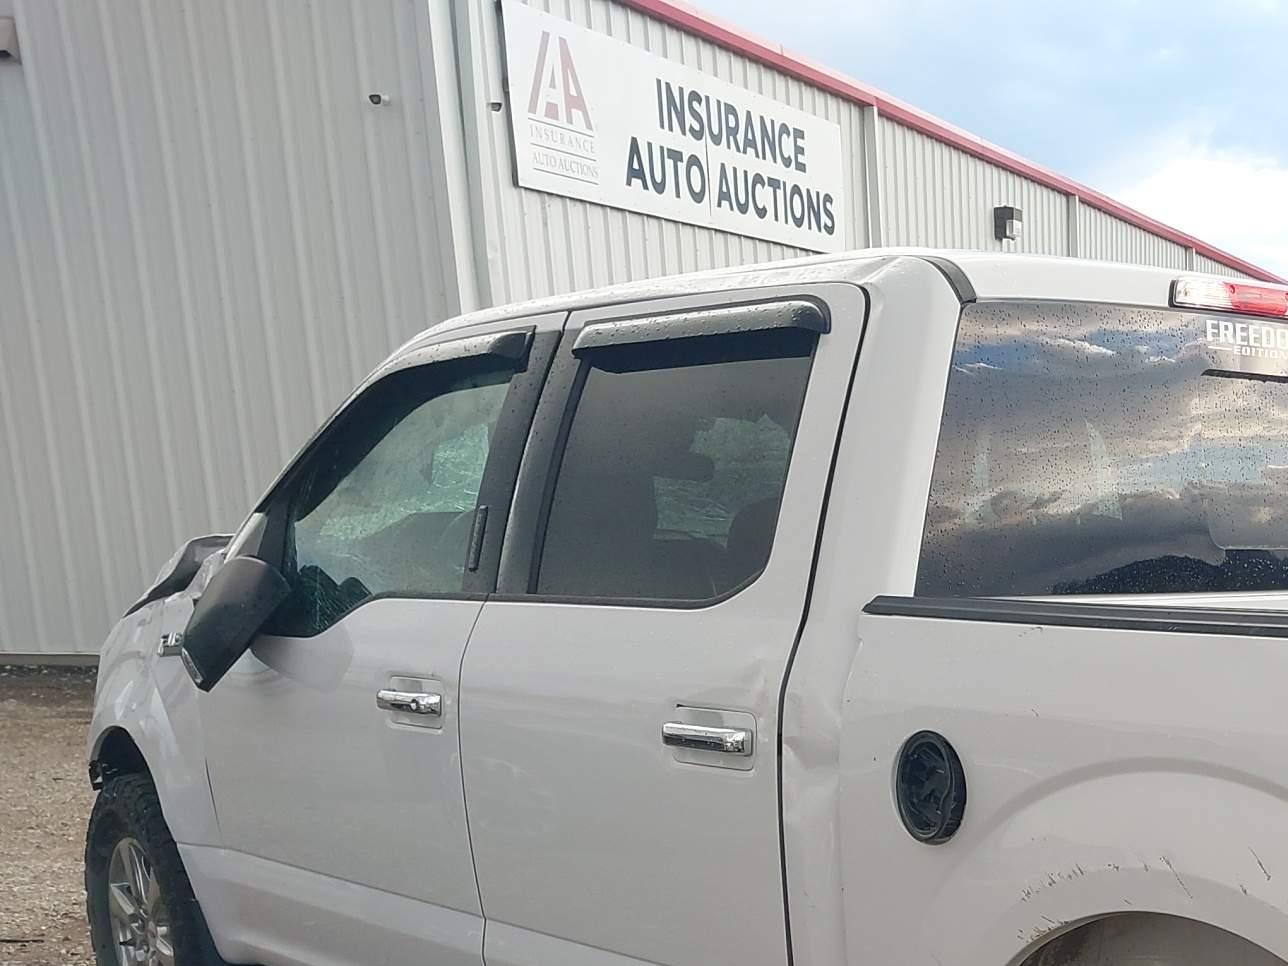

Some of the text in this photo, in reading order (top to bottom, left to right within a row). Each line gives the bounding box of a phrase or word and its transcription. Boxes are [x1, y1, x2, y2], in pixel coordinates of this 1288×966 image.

[530, 124, 595, 154] INSURANCE
[655, 78, 807, 173] INSURANCE
[533, 151, 599, 179] AUTO AUCTIONS
[626, 136, 836, 237] AUTO AUCTIONS
[1233, 345, 1288, 360] EDITION
